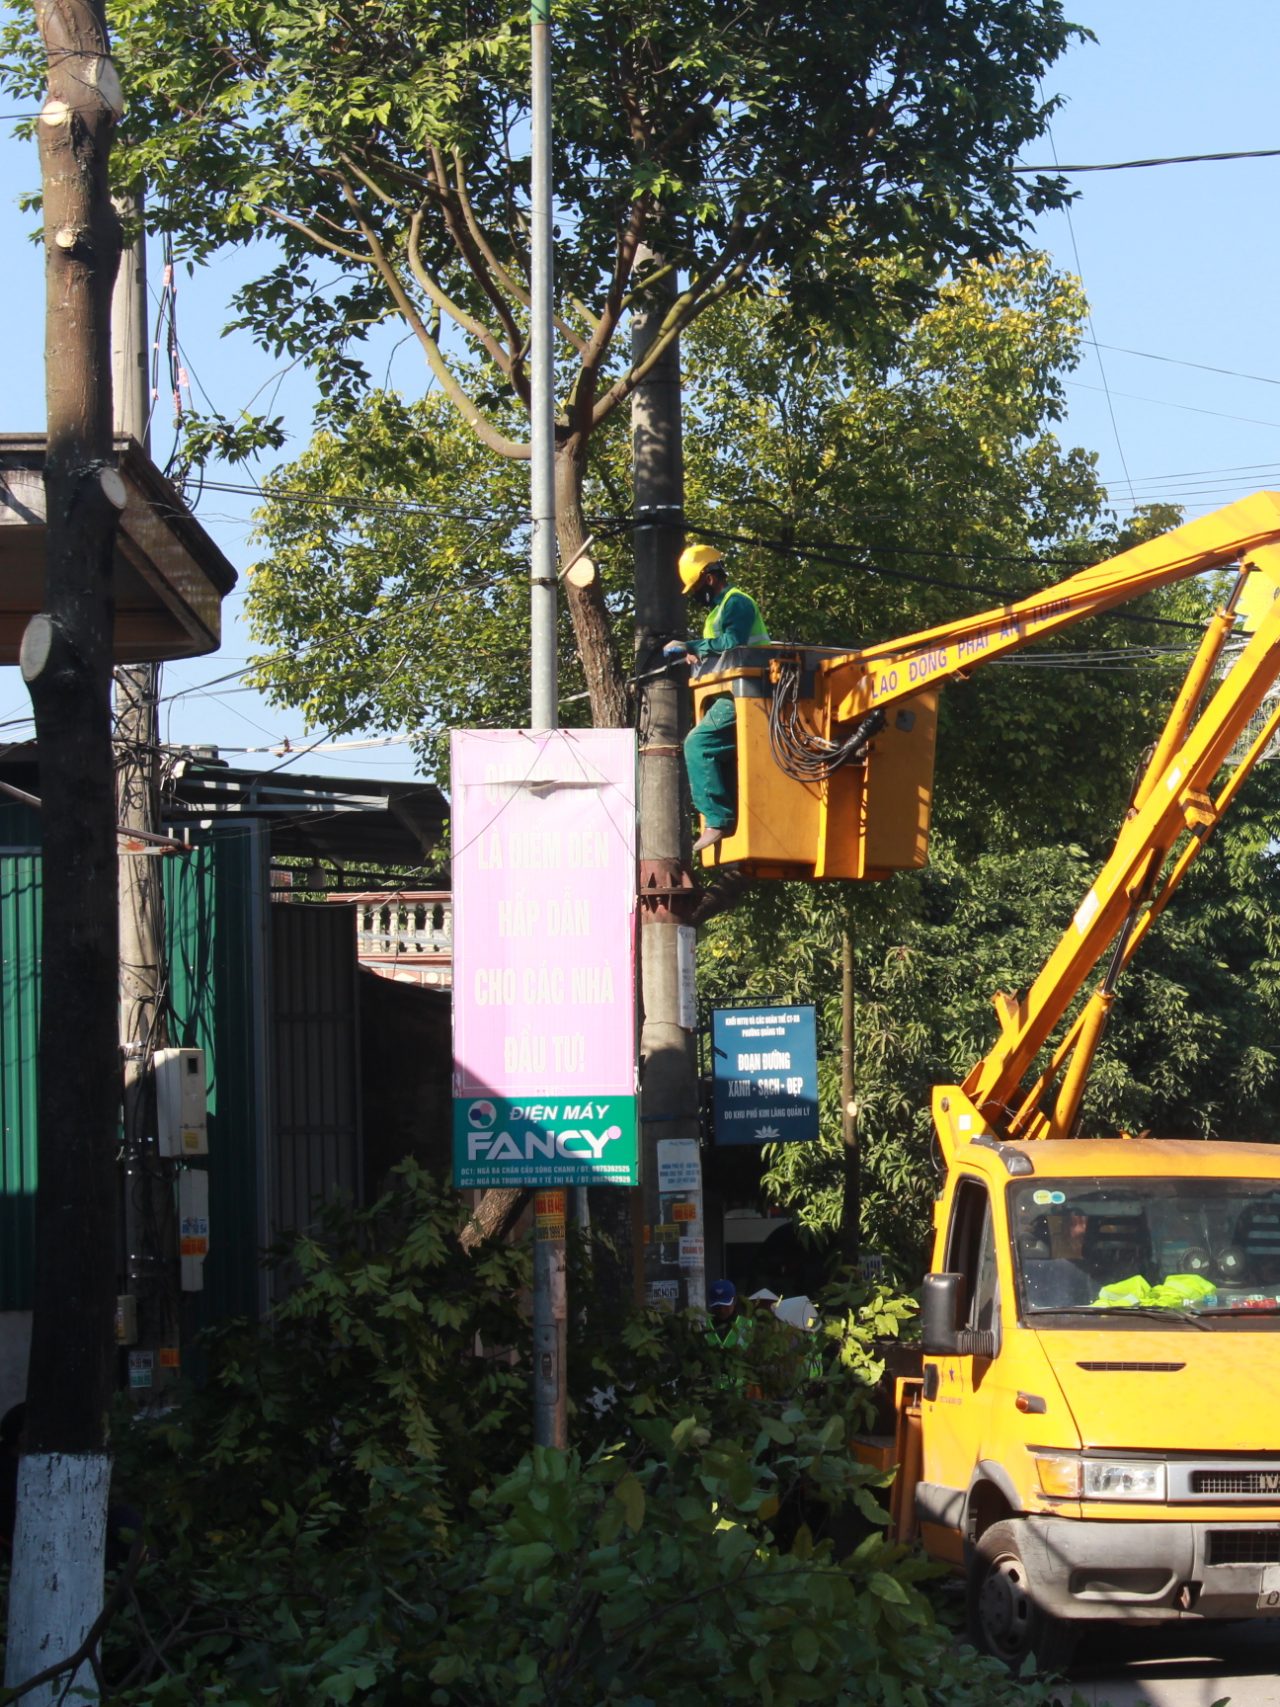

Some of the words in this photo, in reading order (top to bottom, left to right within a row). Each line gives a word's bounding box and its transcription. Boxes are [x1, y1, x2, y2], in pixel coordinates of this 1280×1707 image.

[871, 671, 898, 699] LAO
[498, 887, 541, 937] HẤP
[547, 885, 590, 937] DẪN
[474, 967, 516, 1006] CHO
[523, 960, 565, 1005] CÁC
[571, 960, 615, 1004] NHÀ
[504, 1024, 546, 1073] ĐẦU
[738, 1053, 761, 1074] ĐOẠN
[762, 1049, 791, 1070] ĐƯỜNG
[728, 1079, 751, 1097] XANH
[758, 1077, 780, 1099] SẠCH
[787, 1076, 803, 1097] ĐẸP
[509, 1104, 558, 1124] ĐIỆN
[563, 1102, 610, 1120] MÁY
[467, 1129, 613, 1161] FANCY
